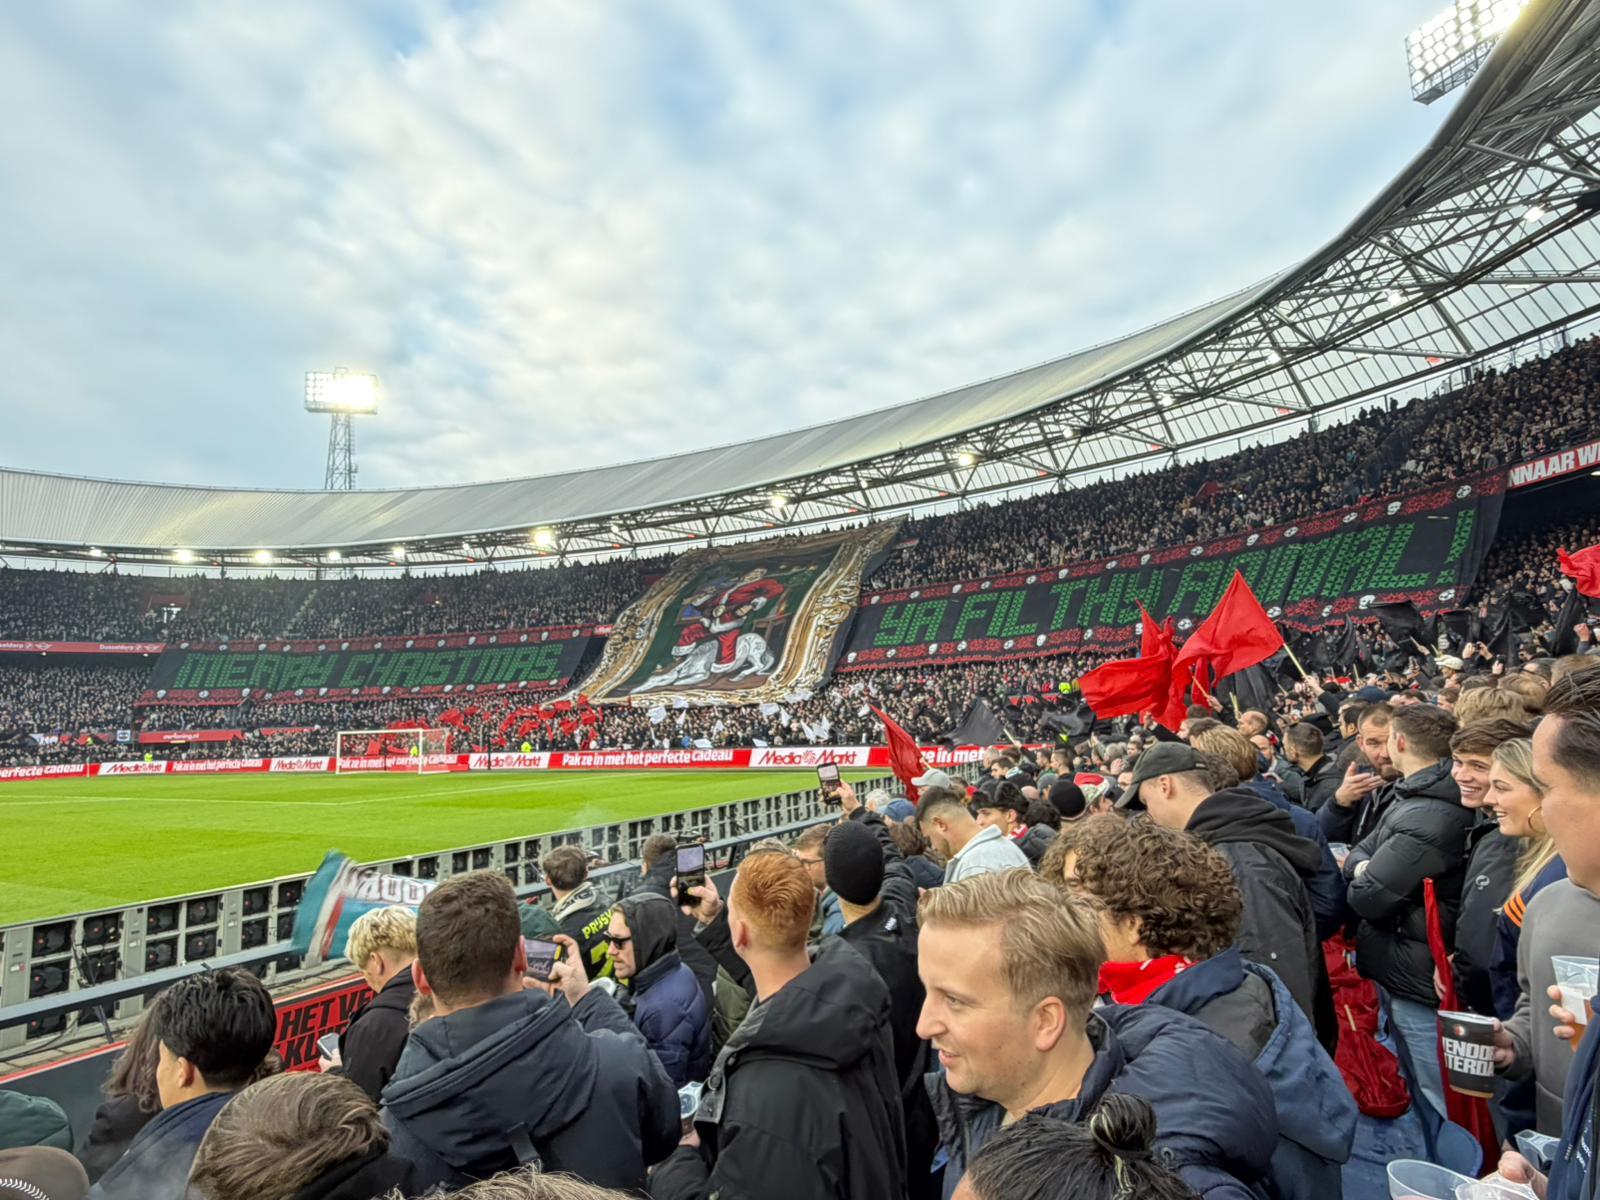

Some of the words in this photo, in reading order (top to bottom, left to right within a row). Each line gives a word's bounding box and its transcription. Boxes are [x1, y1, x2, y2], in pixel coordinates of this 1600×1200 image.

[1576, 441, 1600, 467] W
[874, 599, 948, 647] YA
[339, 643, 564, 687] CHRISTMAS
[513, 755, 541, 767] Markt
[562, 753, 580, 765] Pak
[581, 755, 592, 765] ze
[594, 753, 603, 765] in
[605, 753, 625, 765] met
[626, 752, 644, 764] het
[644, 750, 690, 766] perfecte
[692, 749, 733, 761] cadeau
[758, 751, 804, 766] Media
[814, 750, 858, 765] Markt
[954, 747, 984, 763] met
[44, 764, 85, 774] cadeau
[279, 1000, 337, 1042] HET
